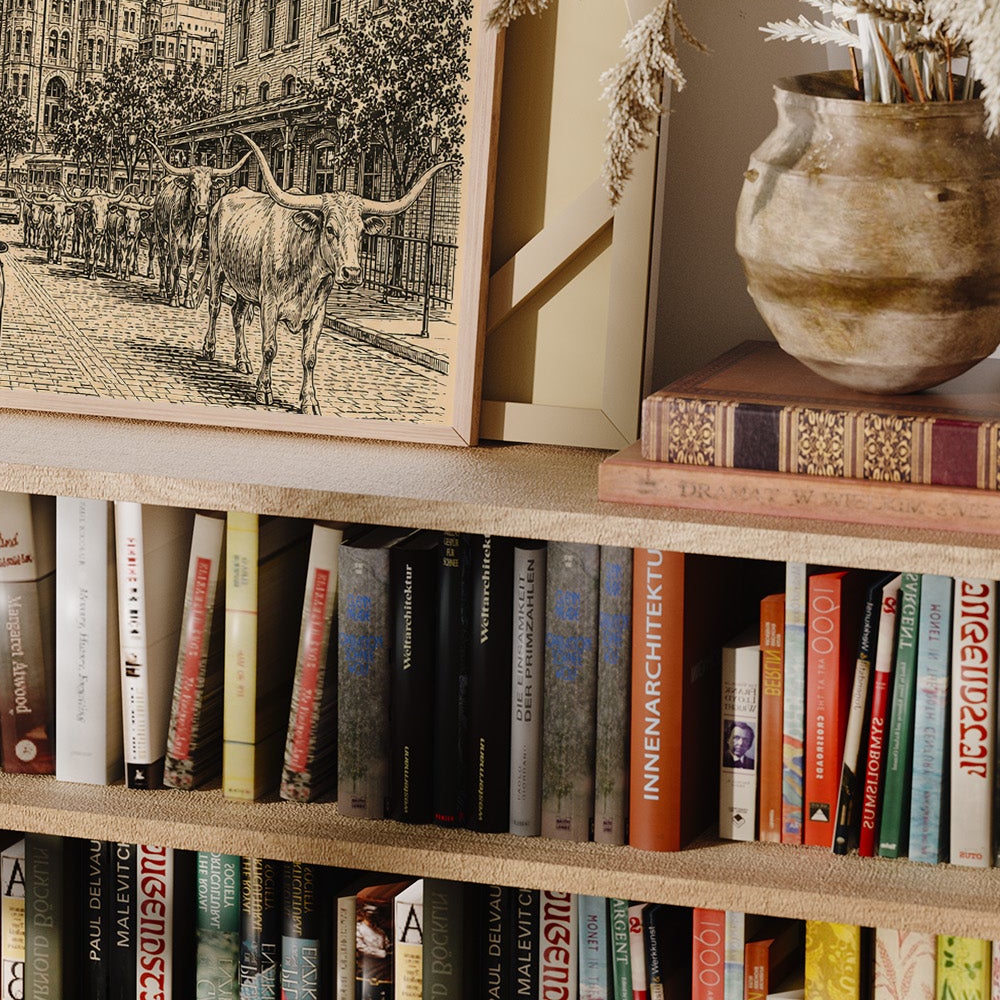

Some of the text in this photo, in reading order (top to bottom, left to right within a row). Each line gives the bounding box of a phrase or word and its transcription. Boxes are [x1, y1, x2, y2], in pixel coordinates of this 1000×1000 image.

[403, 563, 413, 671] Weltarchitektur
[516, 574, 526, 722] DIE EINSAMKEIT
[524, 558, 536, 723] DER PRIMZAHLEN
[6, 595, 33, 714] Margaret Atwood
[402, 745, 410, 814] westermann
[477, 737, 486, 821] westermann
[89, 916, 102, 962] PAUL
[400, 903, 423, 943] A
[586, 914, 599, 969] MONET IN
[648, 925, 660, 976] Werkkunst
[694, 920, 722, 987] 1900
